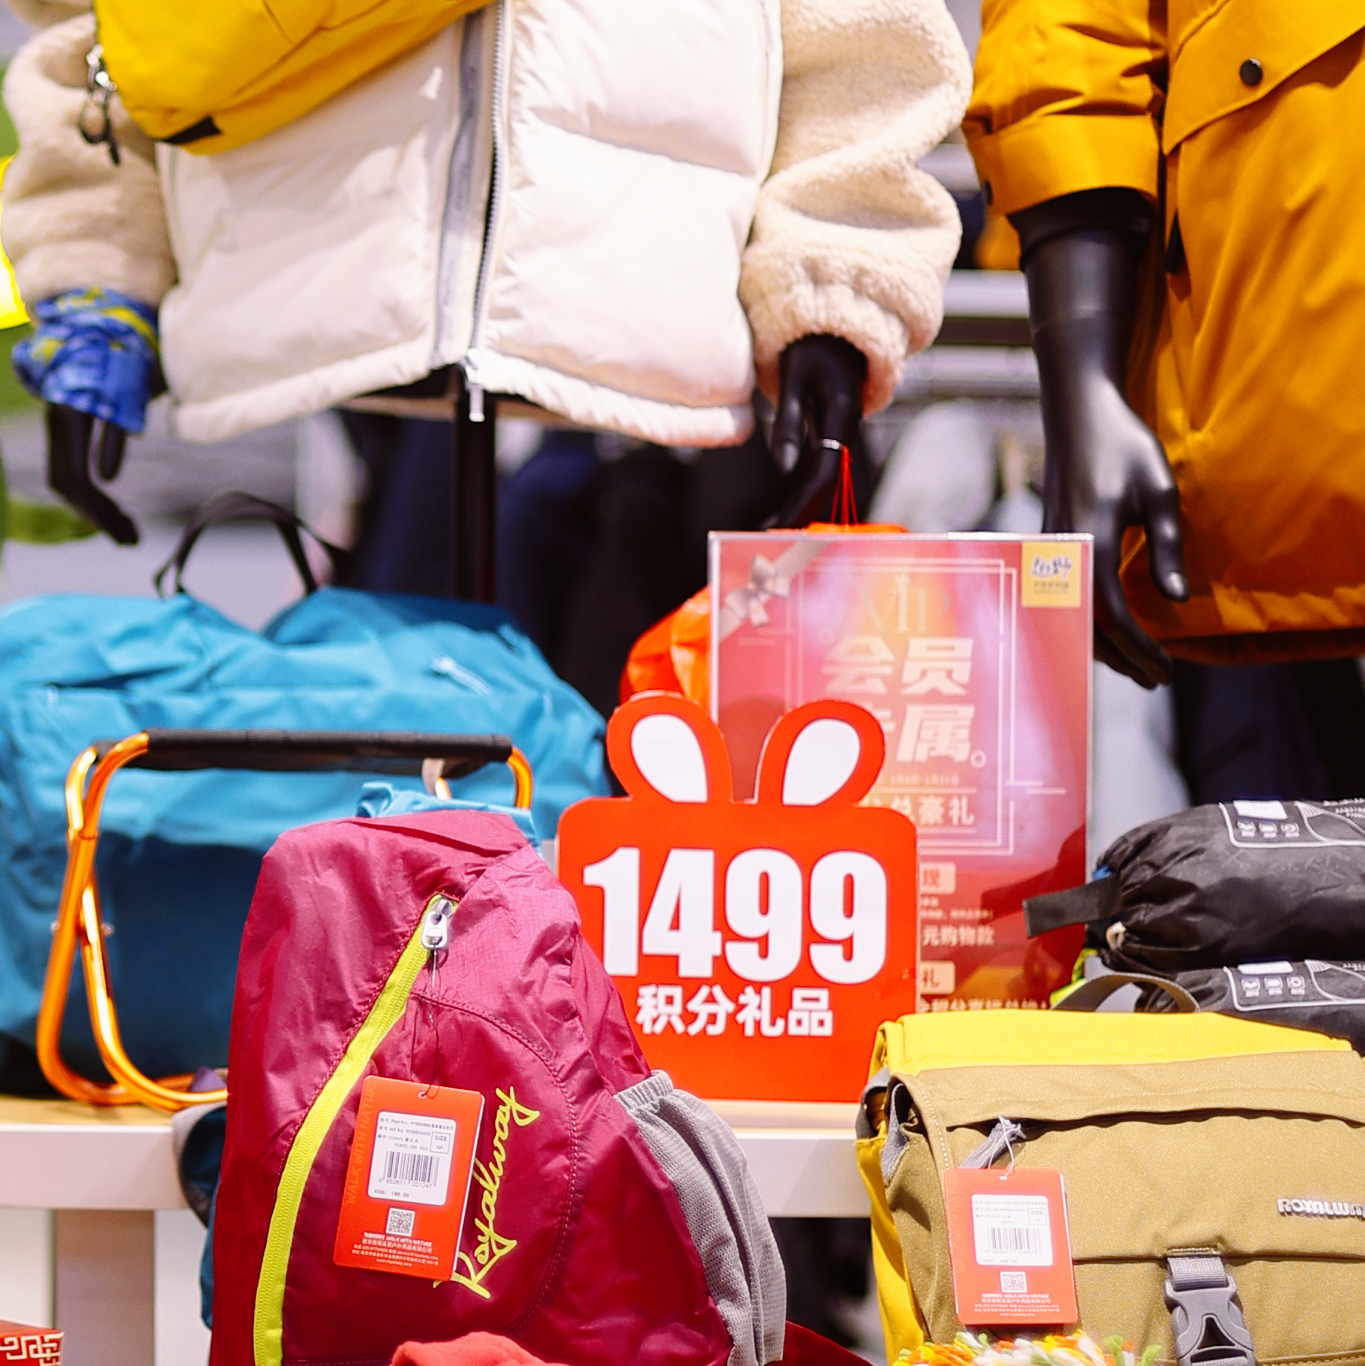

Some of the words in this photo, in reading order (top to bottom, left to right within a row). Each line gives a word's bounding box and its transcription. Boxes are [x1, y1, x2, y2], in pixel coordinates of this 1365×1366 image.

[822, 636, 973, 695] 会员
[583, 848, 887, 984] 1499
[637, 985, 833, 1037] 积分礼品
[358, 1080, 377, 1129] NATURE
[351, 1131, 368, 1164] WITH
[344, 1165, 362, 1204] WALK
[1277, 1198, 1365, 1218] ROYALWA
